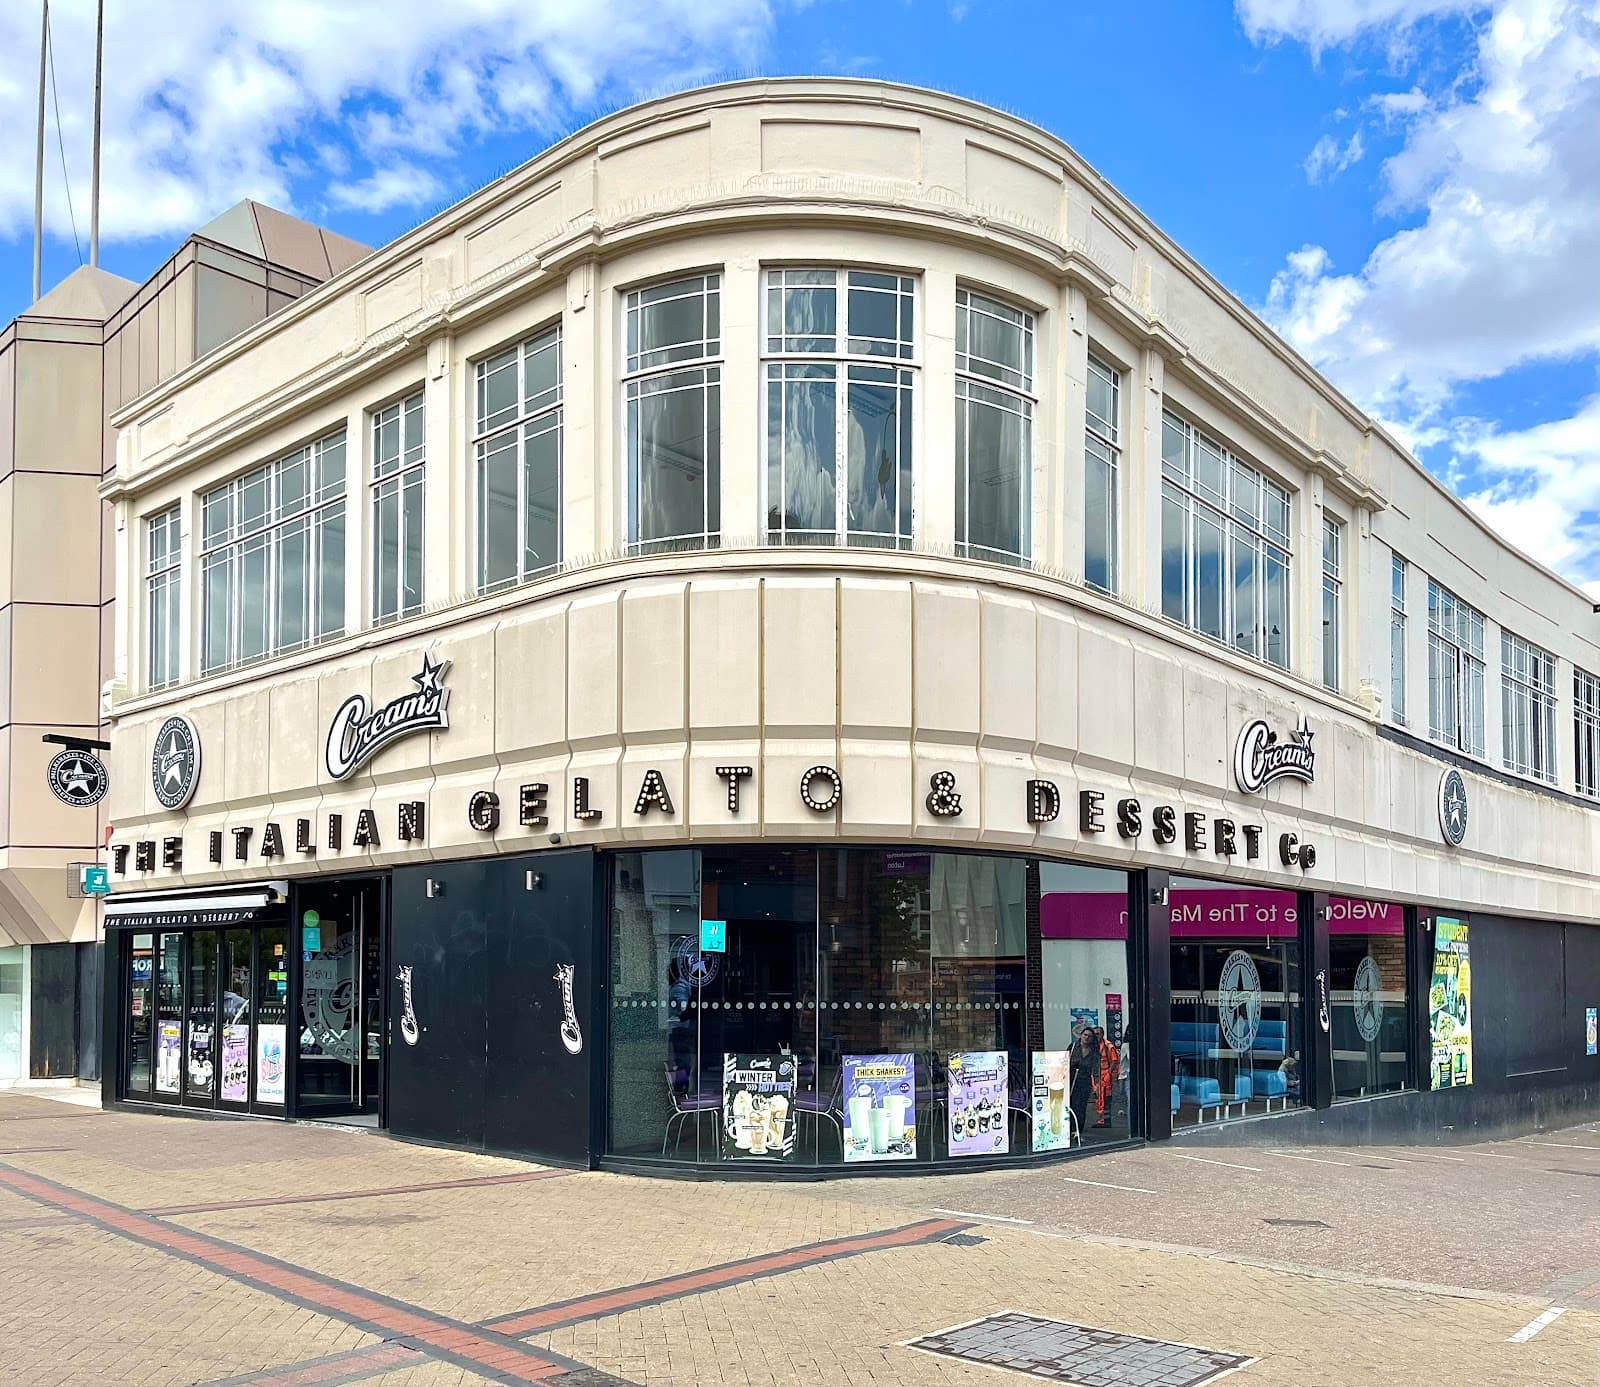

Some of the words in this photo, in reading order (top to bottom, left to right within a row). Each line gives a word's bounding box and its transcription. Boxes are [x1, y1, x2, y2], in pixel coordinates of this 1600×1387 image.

[112, 836, 182, 874] THE
[210, 801, 425, 864] ITALIAN
[469, 765, 842, 832] GELATO
[926, 771, 963, 817] &
[1027, 779, 1263, 860] DESSERT
[105, 918, 121, 926] THE
[123, 917, 153, 926] ITALIAN
[156, 914, 188, 924] GELATO
[202, 912, 240, 923] DESSERT
[738, 1071, 773, 1083] WINTER
[856, 1069, 874, 1077] THICK
[876, 1067, 905, 1076] SHAKES?
